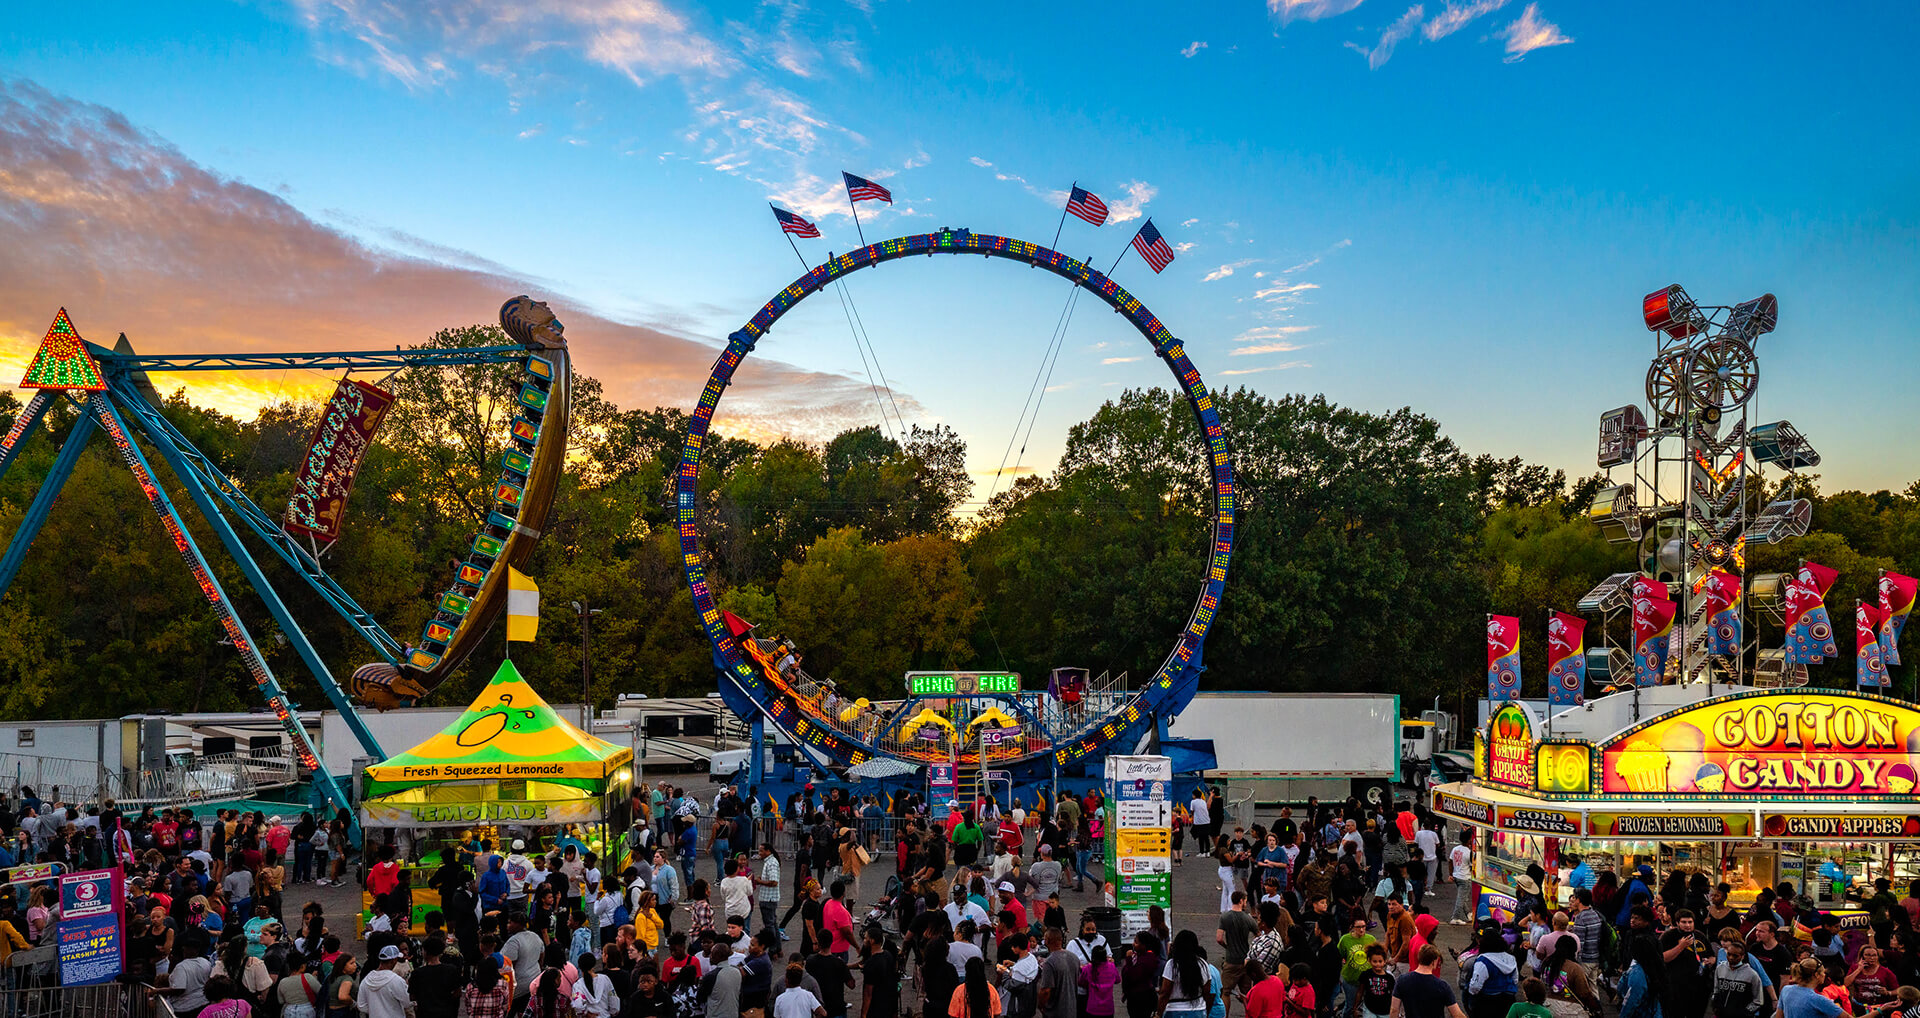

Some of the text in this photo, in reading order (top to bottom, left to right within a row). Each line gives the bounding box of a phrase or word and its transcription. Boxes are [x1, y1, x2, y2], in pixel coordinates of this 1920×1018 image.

[913, 676, 1018, 693] RING OF FIRE
[1713, 702, 1898, 748] COTTON
[1495, 737, 1527, 761] CANDY
[403, 764, 564, 778] Fresh Squeezed Lemonade
[940, 768, 945, 776] 3
[1127, 763, 1162, 774] Little Rock
[1493, 760, 1529, 784] APPLES
[1728, 757, 1886, 790] CANDY
[411, 804, 548, 822] LEMONADE
[1443, 796, 1487, 821] CARAMEL APPLES
[1504, 818, 1576, 832] DRINKS
[1618, 816, 1723, 833] FROZEN LEMONADE
[1788, 818, 1903, 835] CANDY APPLES
[80, 883, 94, 898] 3
[73, 900, 101, 909] TICKETS
[1489, 895, 1509, 908] COTTON
[1840, 916, 1870, 928] OTTO
[63, 930, 87, 942] SIZE
[90, 935, 113, 949] 42"
[61, 950, 97, 962] STARSHIP
[1719, 981, 1746, 992] LOVE
